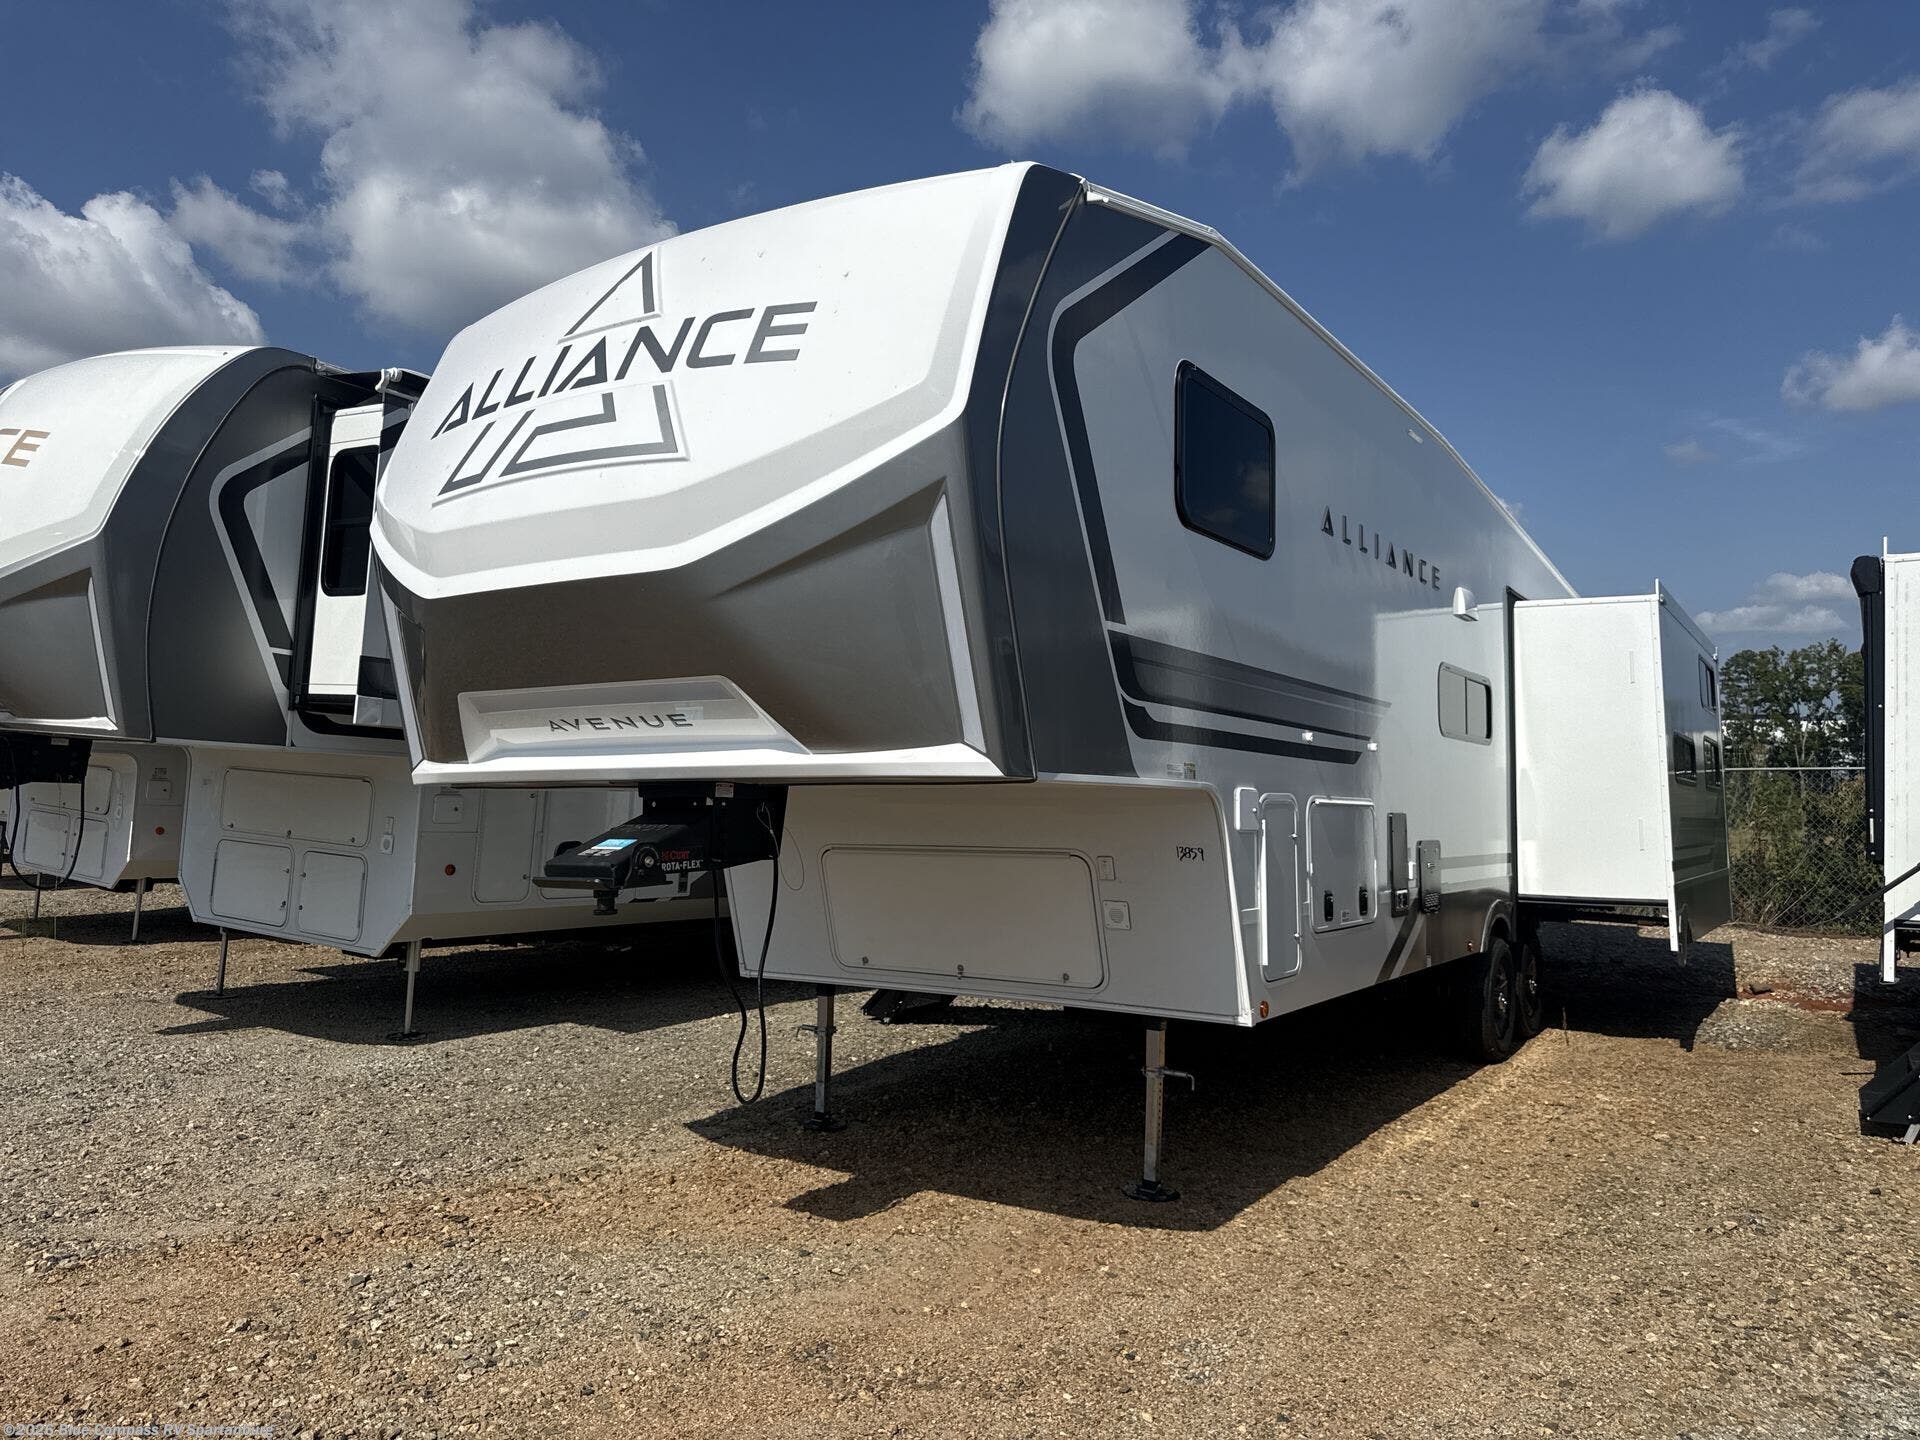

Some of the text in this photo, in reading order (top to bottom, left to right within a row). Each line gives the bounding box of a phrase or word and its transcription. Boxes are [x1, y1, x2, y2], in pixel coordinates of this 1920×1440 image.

[430, 301, 818, 440] ALLIANCE
[1320, 505, 1441, 591] ALLIANCE
[548, 713, 694, 732] AVENUE
